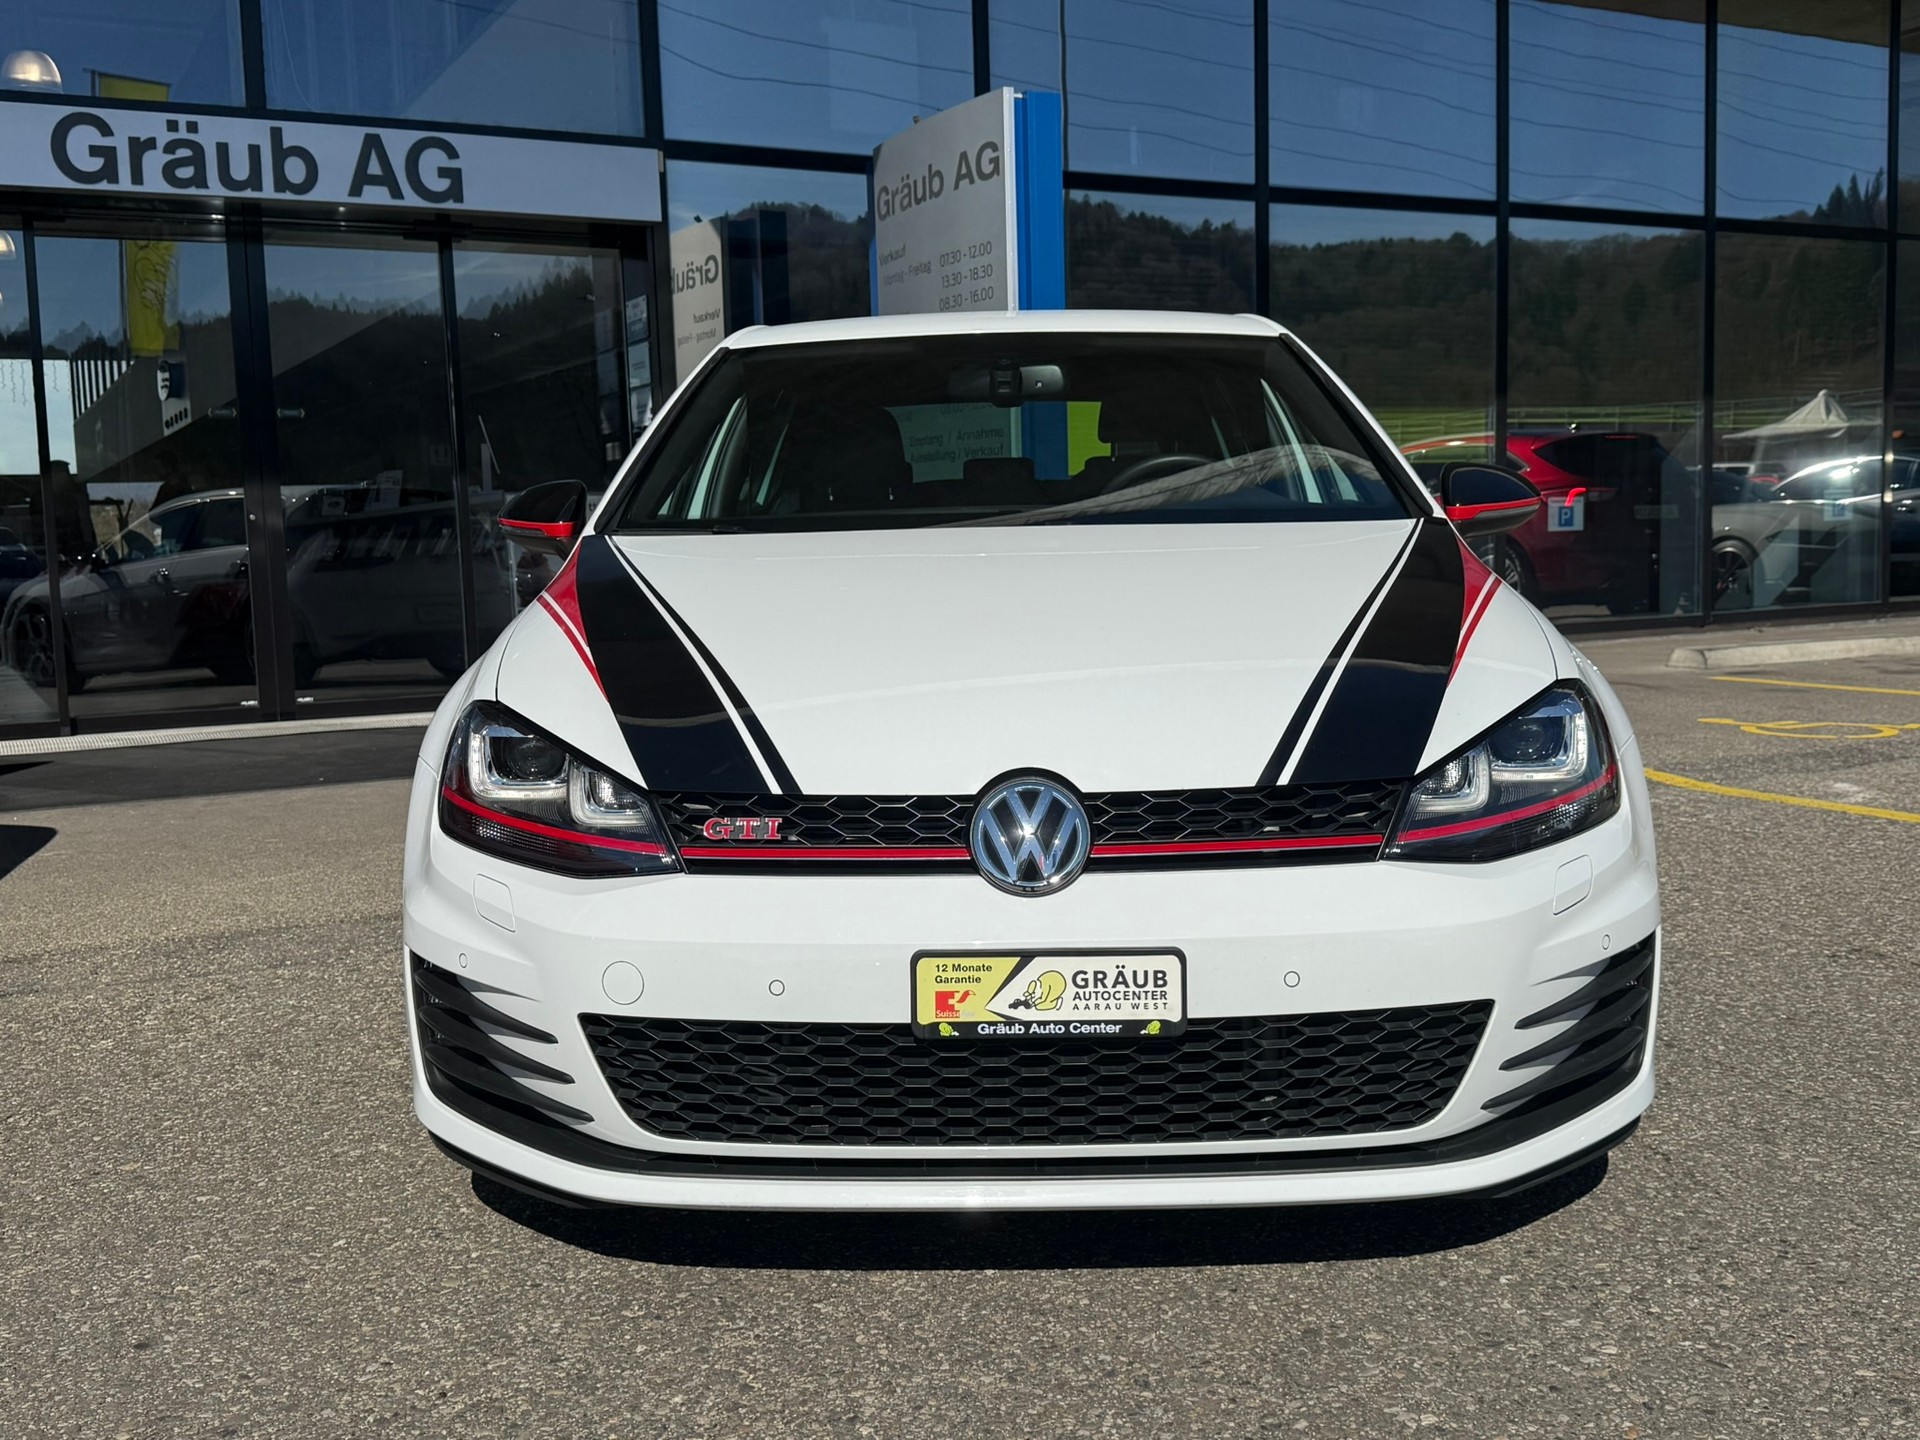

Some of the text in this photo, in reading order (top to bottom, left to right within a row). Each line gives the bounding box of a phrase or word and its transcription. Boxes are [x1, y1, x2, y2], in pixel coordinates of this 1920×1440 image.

[49, 111, 464, 204] Gräub AG
[877, 141, 1000, 221] Gräub AG
[940, 249, 962, 267] 07.30
[968, 241, 993, 259] 12.00
[941, 271, 963, 288] 13.30
[969, 263, 994, 281] 18.30
[969, 286, 994, 304] 16.00
[957, 427, 1004, 442] Annahme
[963, 442, 1004, 458] Verkauf
[703, 817, 783, 840] GTI
[935, 963, 992, 972] 12 Monate
[934, 975, 982, 984] Garantie
[1071, 964, 1168, 989] GRÄUB
[1072, 990, 1168, 1001] AUTOCENTER
[1072, 1002, 1168, 1011] AARAU WEST
[977, 1022, 1122, 1035] Gräub Auto Center
